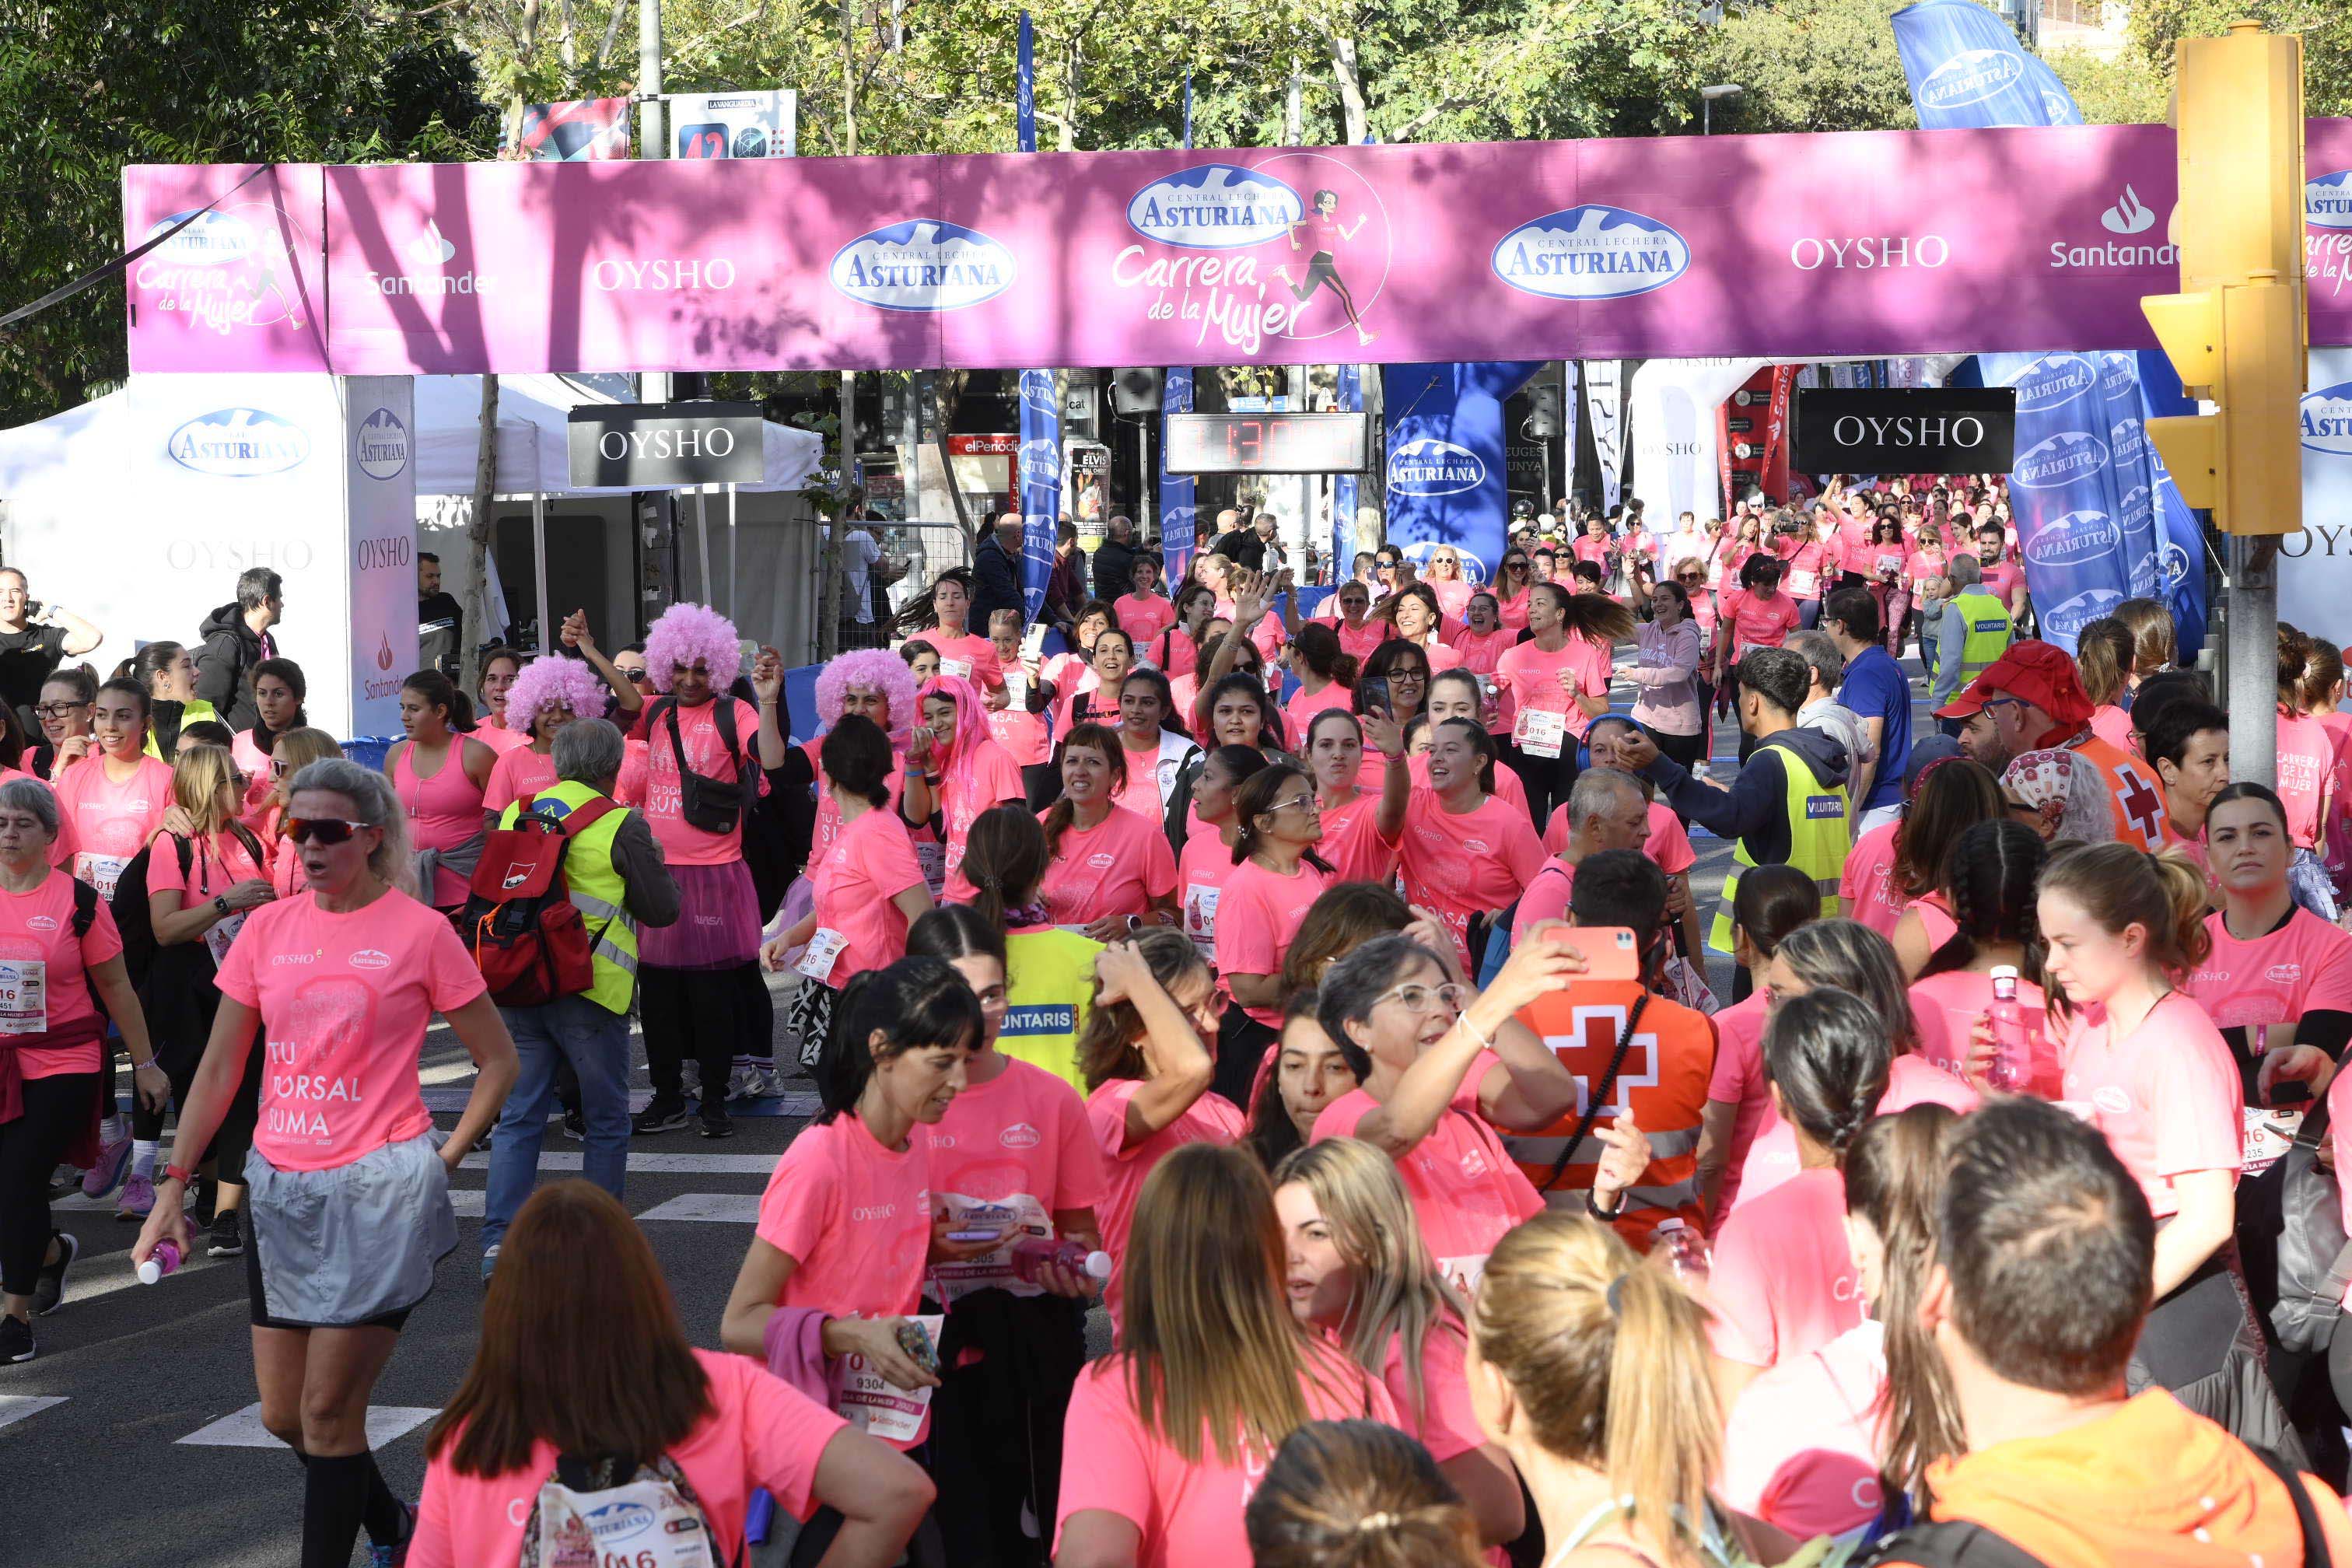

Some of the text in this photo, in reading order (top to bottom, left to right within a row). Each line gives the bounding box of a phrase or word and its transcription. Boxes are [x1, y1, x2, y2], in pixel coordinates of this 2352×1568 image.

[1168, 194, 1223, 202] CENTRAL
[1140, 196, 1290, 228] ASTURIANA
[1538, 236, 1668, 247] CENTRAL LECHERA
[1791, 234, 1949, 270] OYSHO
[873, 251, 931, 261] CENTRAL
[1112, 245, 1258, 288] Carrera
[1507, 240, 1675, 276] ASTURIANA
[2323, 255, 2337, 278] la
[137, 261, 229, 292] Carrera
[594, 258, 736, 292] OYSHO
[845, 254, 1002, 288] ASTURIANA
[366, 271, 496, 296] Santander
[159, 293, 175, 312] de
[178, 296, 191, 312] la
[1147, 282, 1311, 355] de la Mujer
[1833, 415, 1985, 448] OYSHO
[180, 434, 300, 459] ASTURIANA
[360, 436, 406, 462] ASTURIANA
[599, 428, 734, 460] OYSHO
[1082, 455, 1107, 465] ELVIS
[1389, 463, 1479, 484] ASTURIANA
[2277, 524, 2352, 558] OY
[166, 538, 313, 571] OYSHO
[358, 535, 410, 571] OYSHO
[1529, 726, 1546, 736] 016
[2283, 766, 2310, 779] DE LA
[2278, 778, 2312, 792] MUJER
[821, 813, 832, 824] TU
[1414, 825, 1443, 842] OYSHO
[694, 915, 723, 926] NASA
[1203, 916, 1214, 926] 01
[273, 954, 314, 966] OYSHO
[0, 989, 16, 1000] 16
[268, 1041, 296, 1065] TU
[268, 1108, 330, 1136] SUMA
[2244, 1128, 2265, 1144] 16
[852, 1203, 896, 1222] OYSHO
[857, 1377, 885, 1391] 9304
[877, 1416, 912, 1430] Santander
